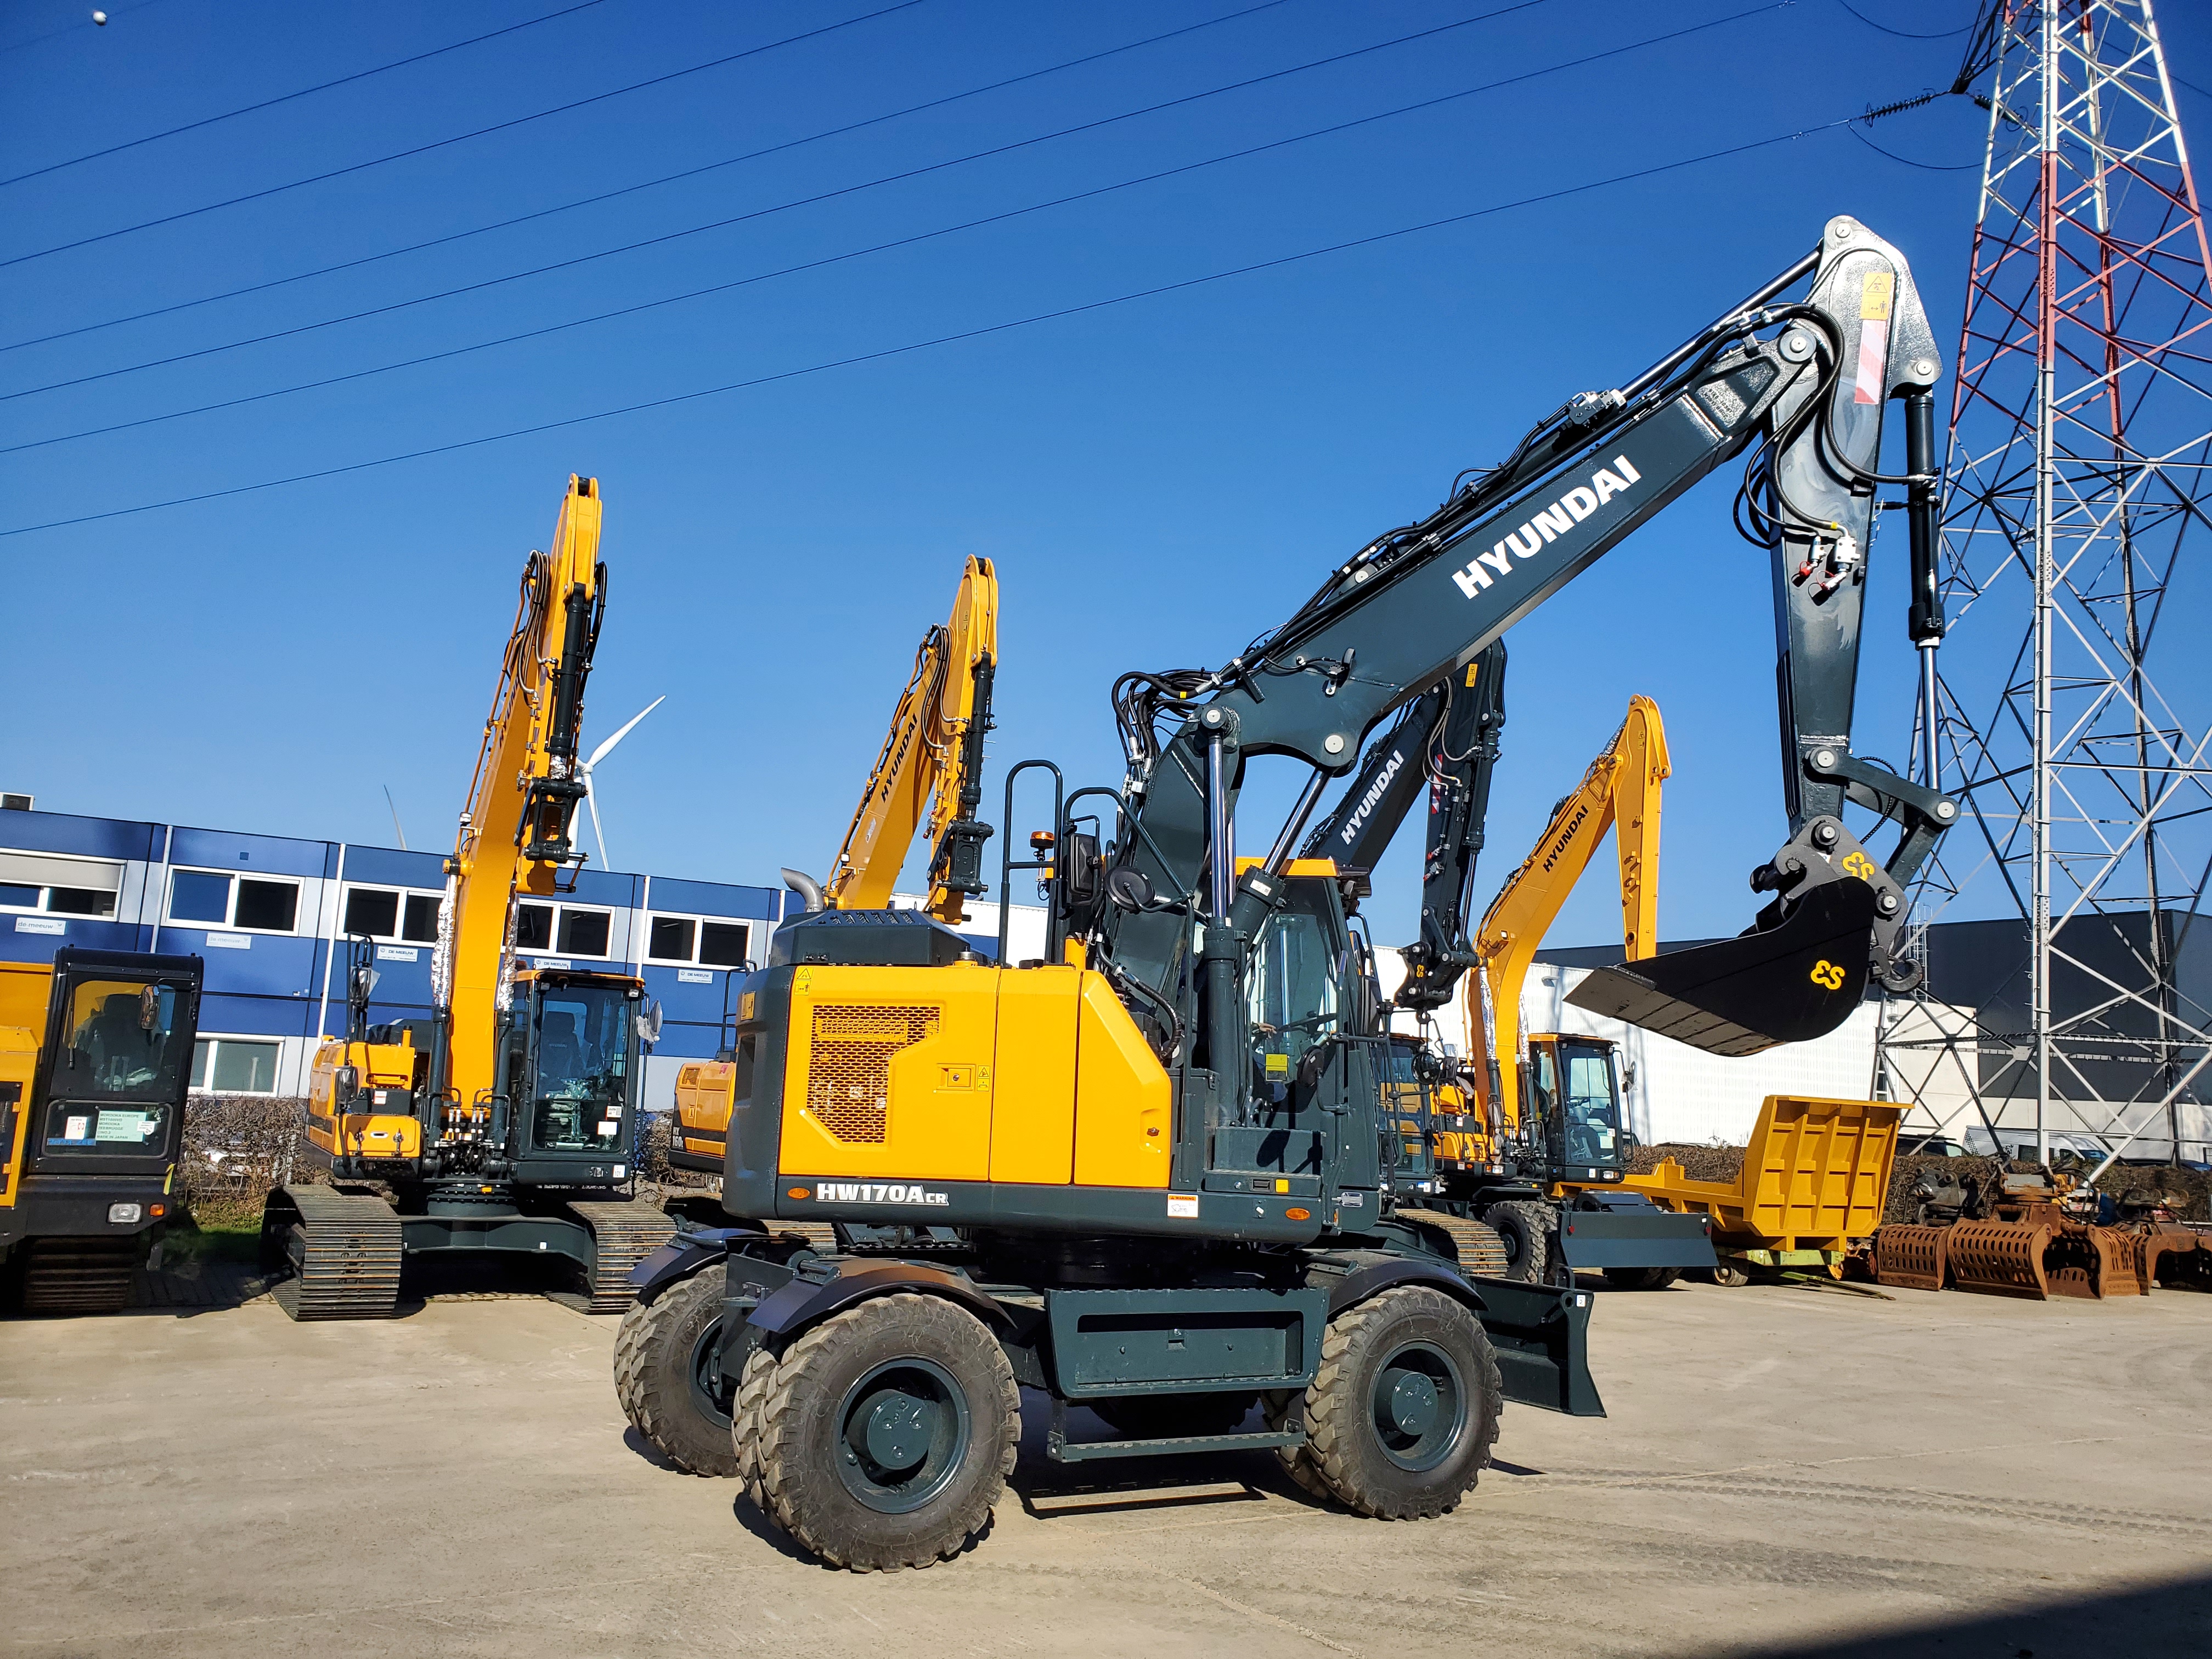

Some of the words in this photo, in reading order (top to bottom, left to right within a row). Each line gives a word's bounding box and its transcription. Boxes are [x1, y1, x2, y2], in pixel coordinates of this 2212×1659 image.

[1452, 455, 1641, 600] HYUNDAI
[881, 713, 918, 803] HYUNDAI
[1341, 749, 1404, 845] HYUNDAI
[1543, 804, 1588, 873] HYUNDAI
[817, 1183, 949, 1205] HW170ACR
